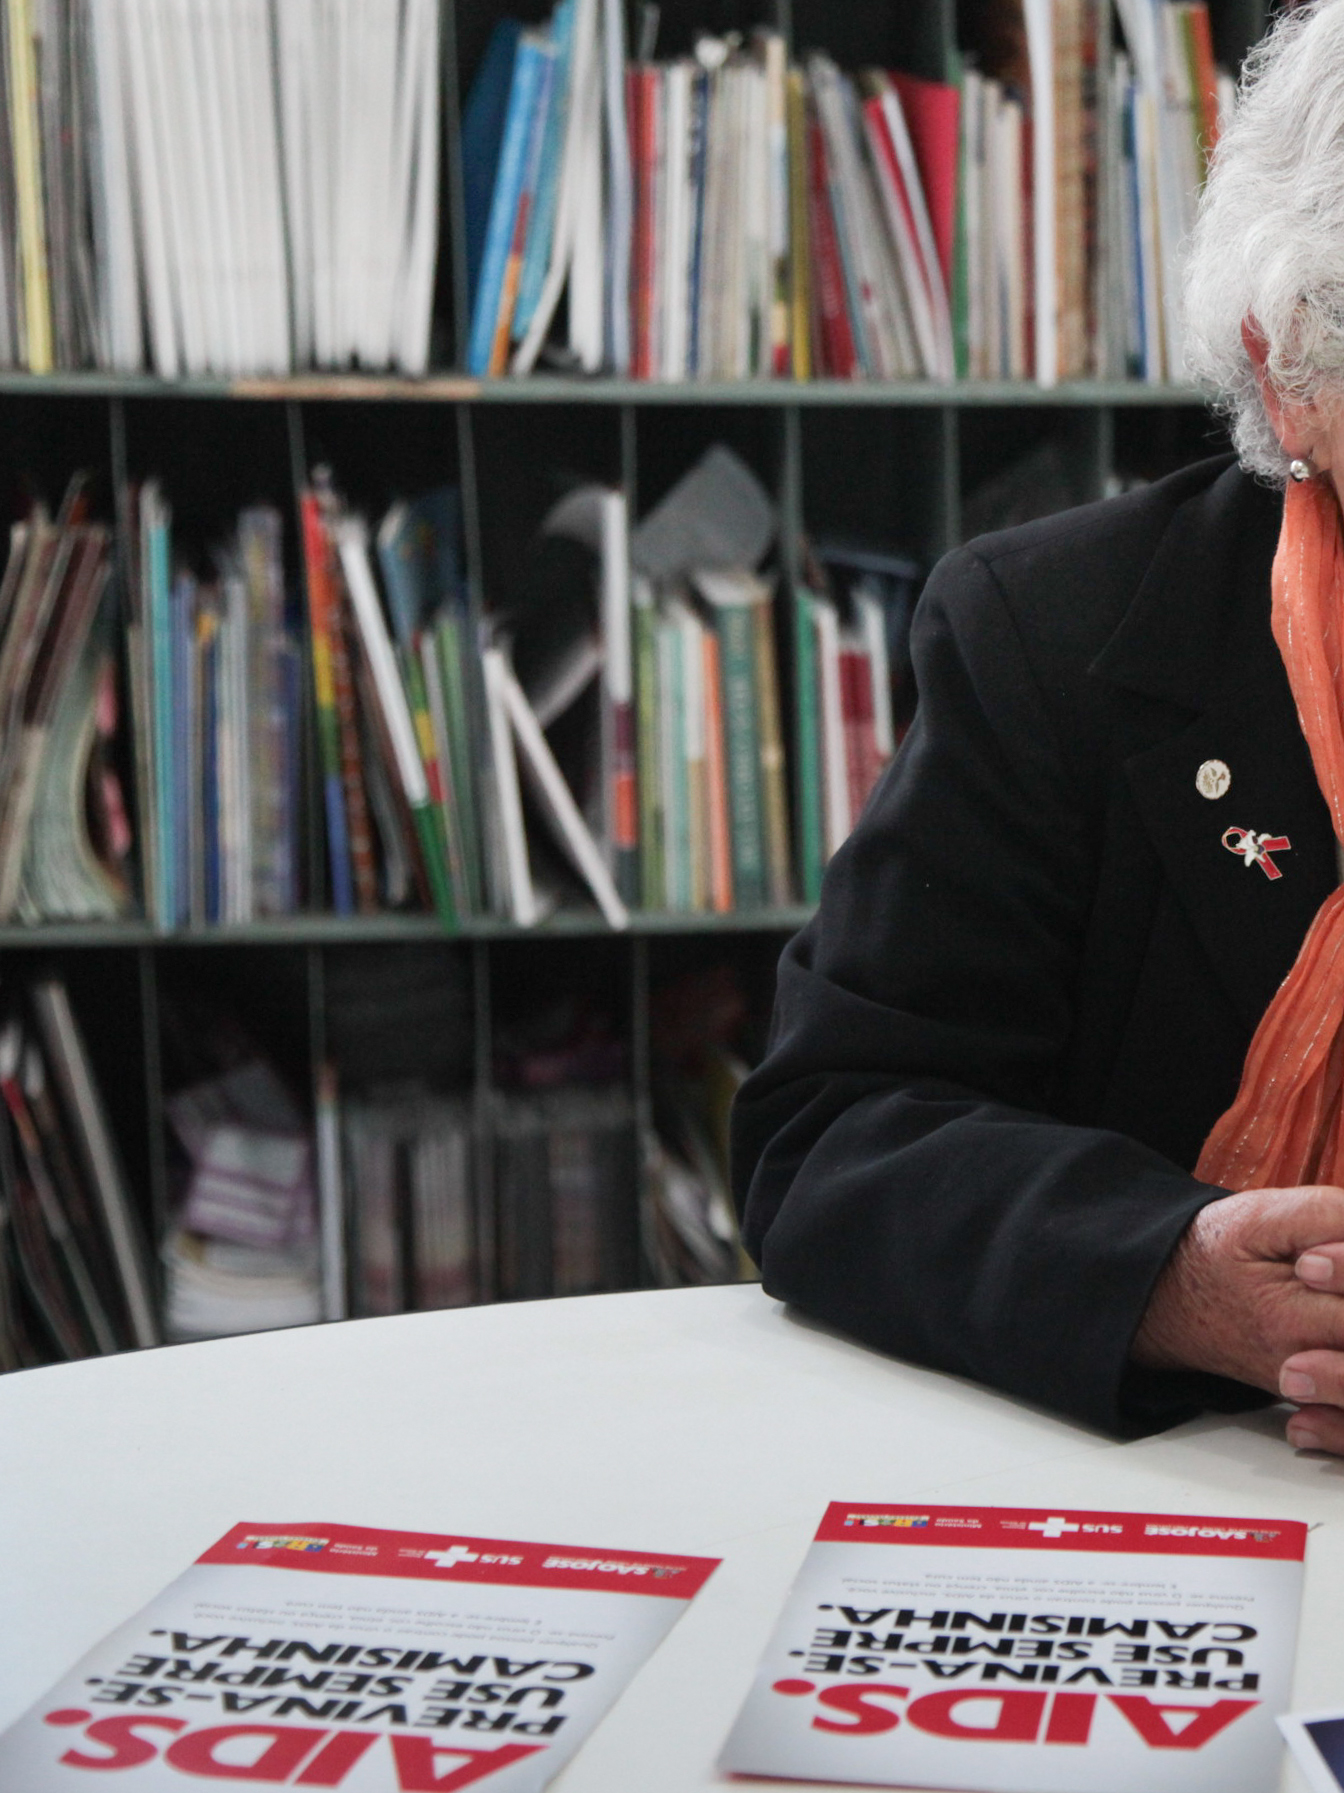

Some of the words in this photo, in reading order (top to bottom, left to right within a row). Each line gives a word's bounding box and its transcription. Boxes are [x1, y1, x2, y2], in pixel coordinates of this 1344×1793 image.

[1082, 1524, 1123, 1535] SUS
[479, 1554, 524, 1566] SUS
[818, 1605, 1258, 1643] CAMISINHA.
[149, 1630, 595, 1684] CAMISINHA.
[811, 1628, 1093, 1661] SEMPRE
[1112, 1643, 1244, 1668] USE
[115, 1655, 413, 1698] SEMPRE
[788, 1651, 1260, 1693] PREVINA-SE.
[85, 1678, 567, 1738] PREVINA-SE.
[423, 1679, 565, 1710] USE
[772, 1679, 1263, 1751] AIDS.
[43, 1708, 551, 1793] AIDS.
